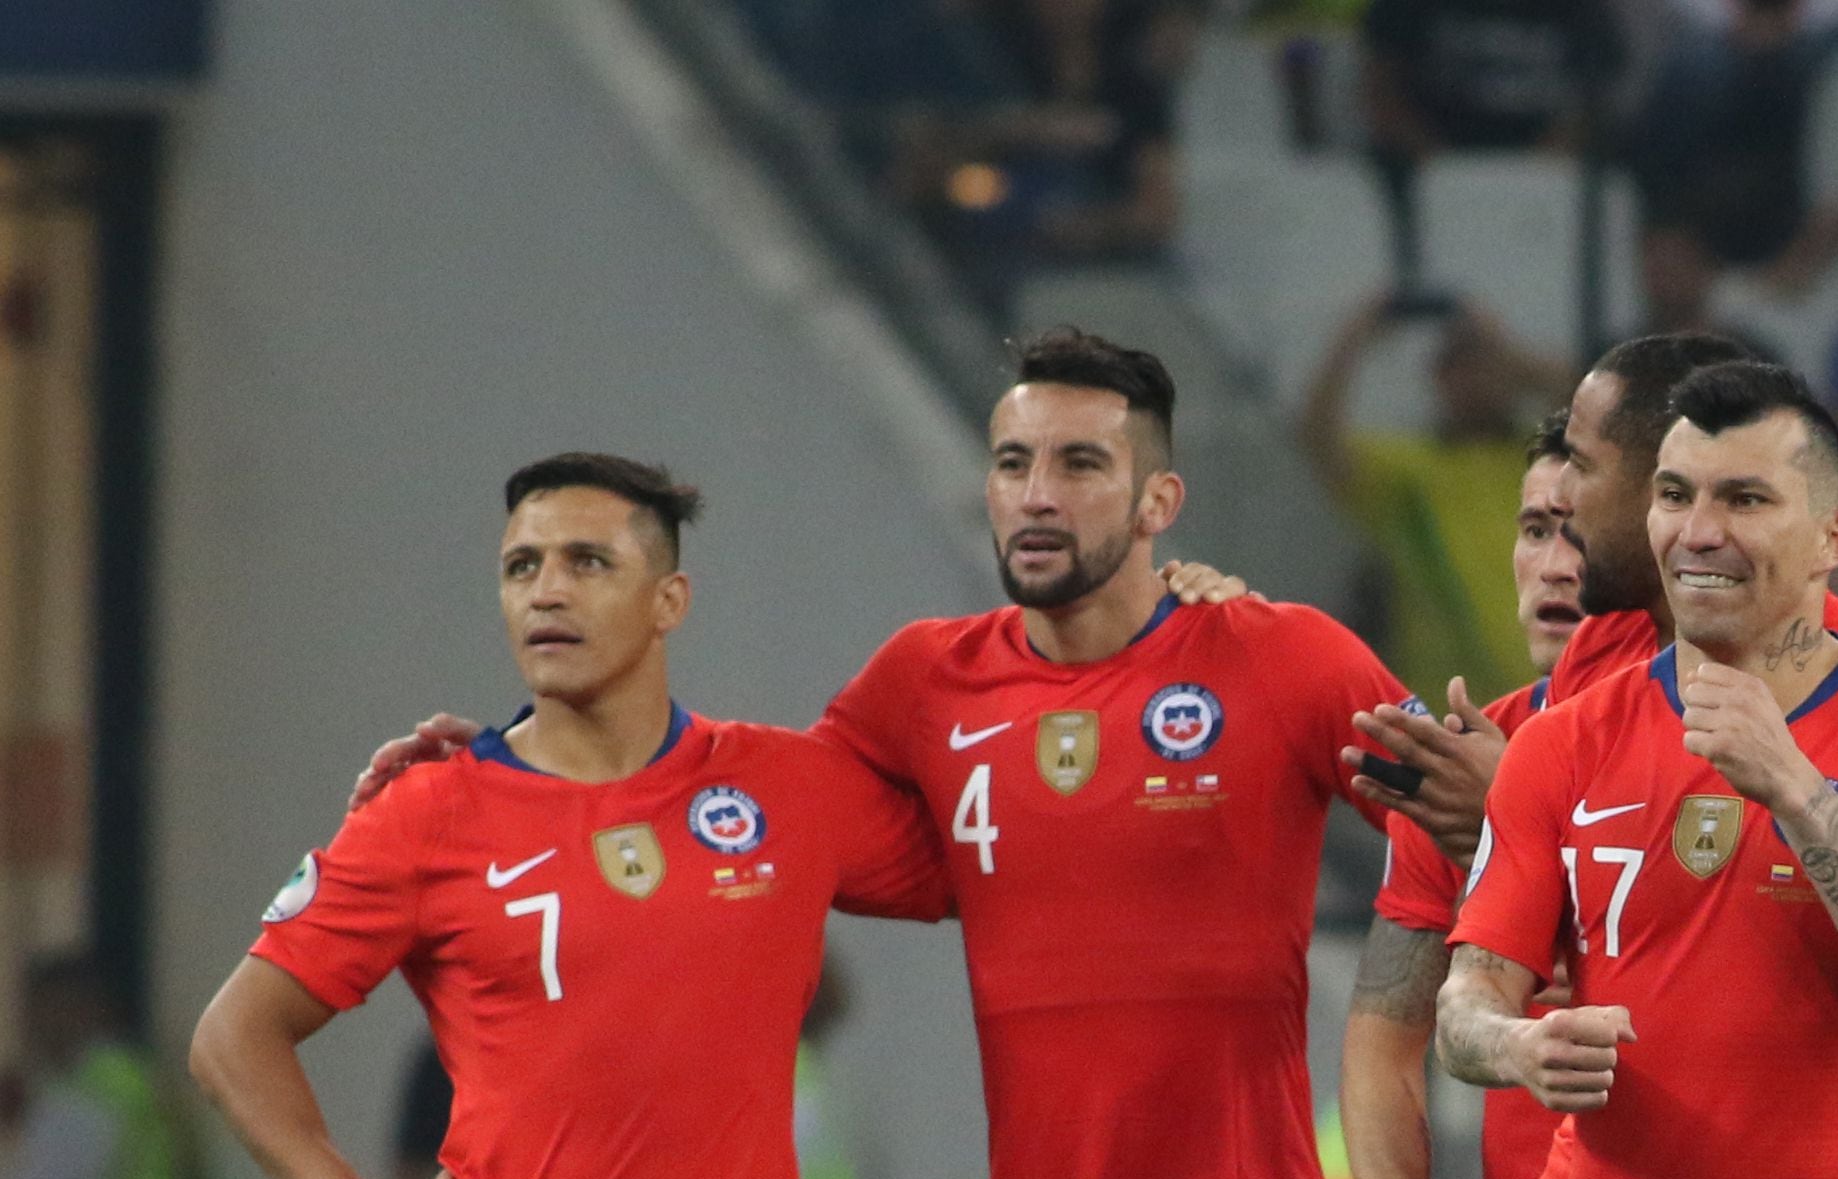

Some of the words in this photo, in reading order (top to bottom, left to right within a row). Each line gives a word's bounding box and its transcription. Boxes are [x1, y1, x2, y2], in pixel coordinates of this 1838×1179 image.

[953, 764, 998, 874] 4
[505, 892, 564, 1001] 7
[1561, 847, 1645, 957] 17
